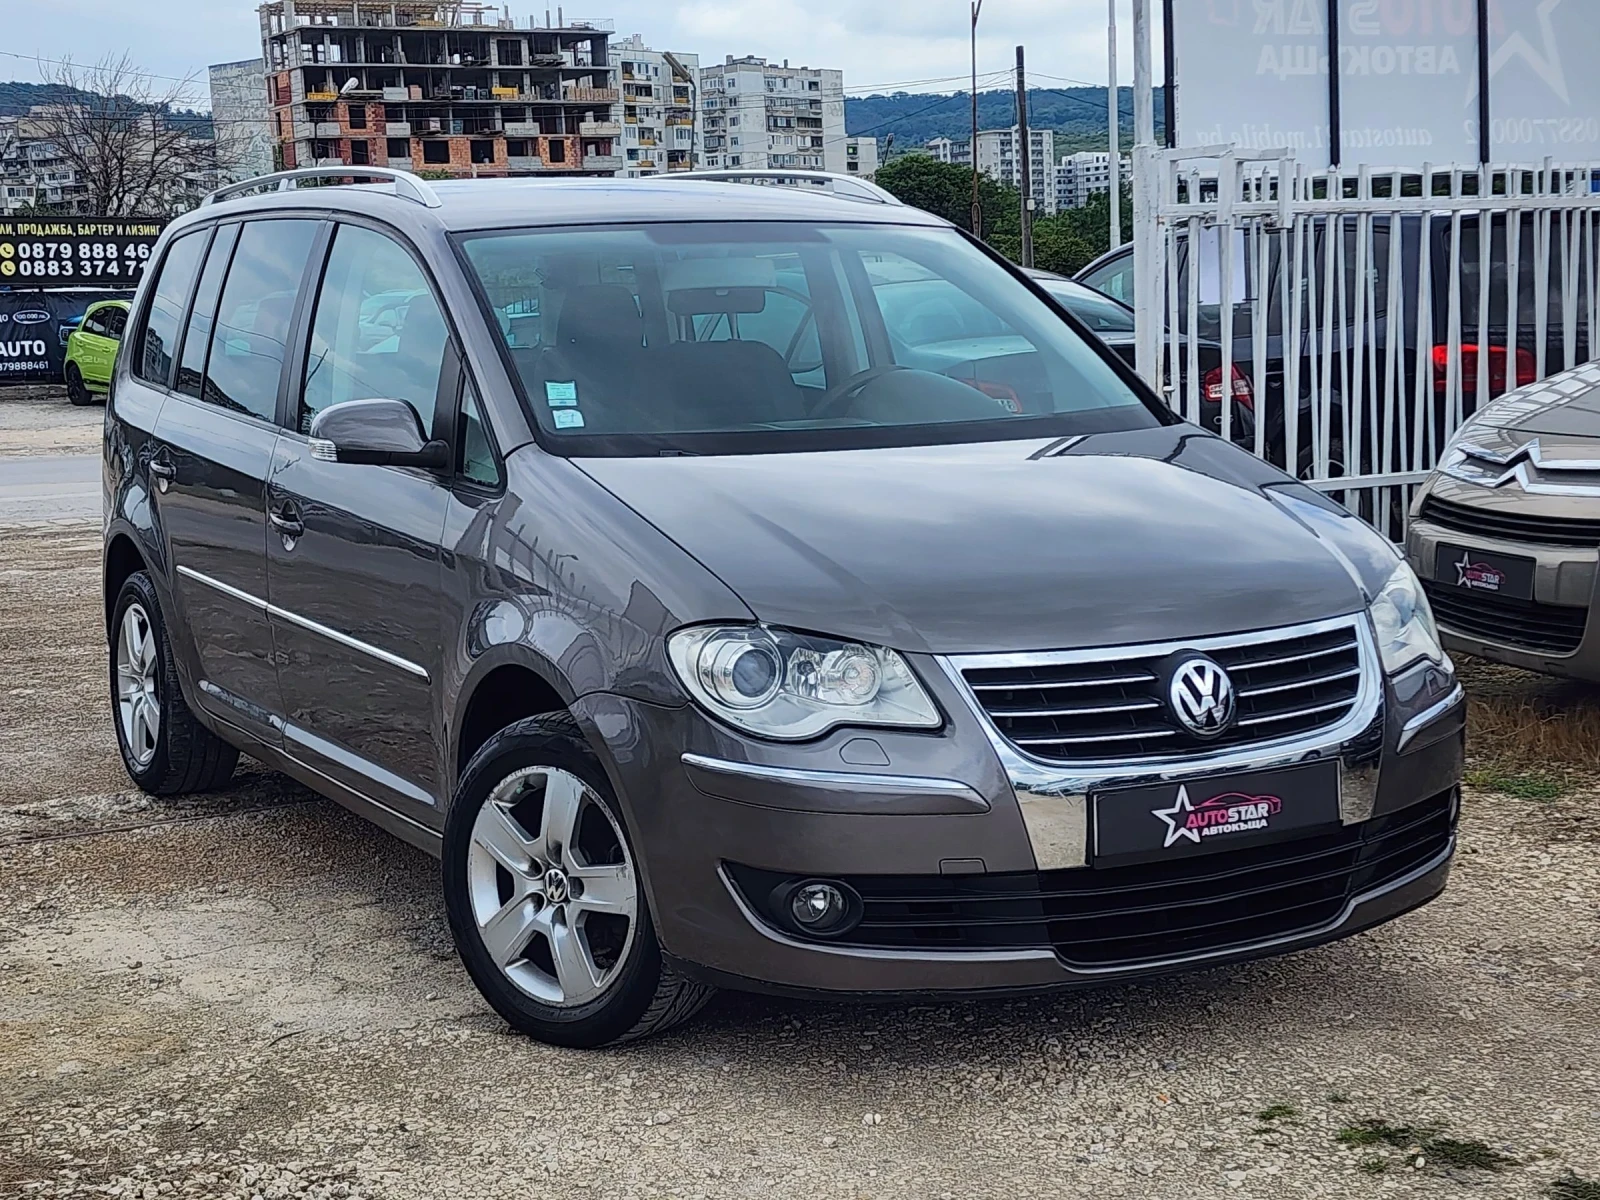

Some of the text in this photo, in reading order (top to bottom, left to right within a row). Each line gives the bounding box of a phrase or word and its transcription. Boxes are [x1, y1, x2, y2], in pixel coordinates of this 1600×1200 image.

[17, 223, 76, 237] ПРОДАЖБА,
[77, 224, 114, 236] БАРТЕР
[116, 225, 123, 236] И
[125, 225, 160, 236] ЛИЗИНГ
[18, 243, 152, 259] 0879 888 46
[19, 260, 73, 276] 0883
[80, 260, 119, 276] 374
[0, 340, 46, 357] AUTO
[1185, 803, 1269, 829] AUTOSTAR
[1201, 818, 1268, 837] АВТОКЪЩА
